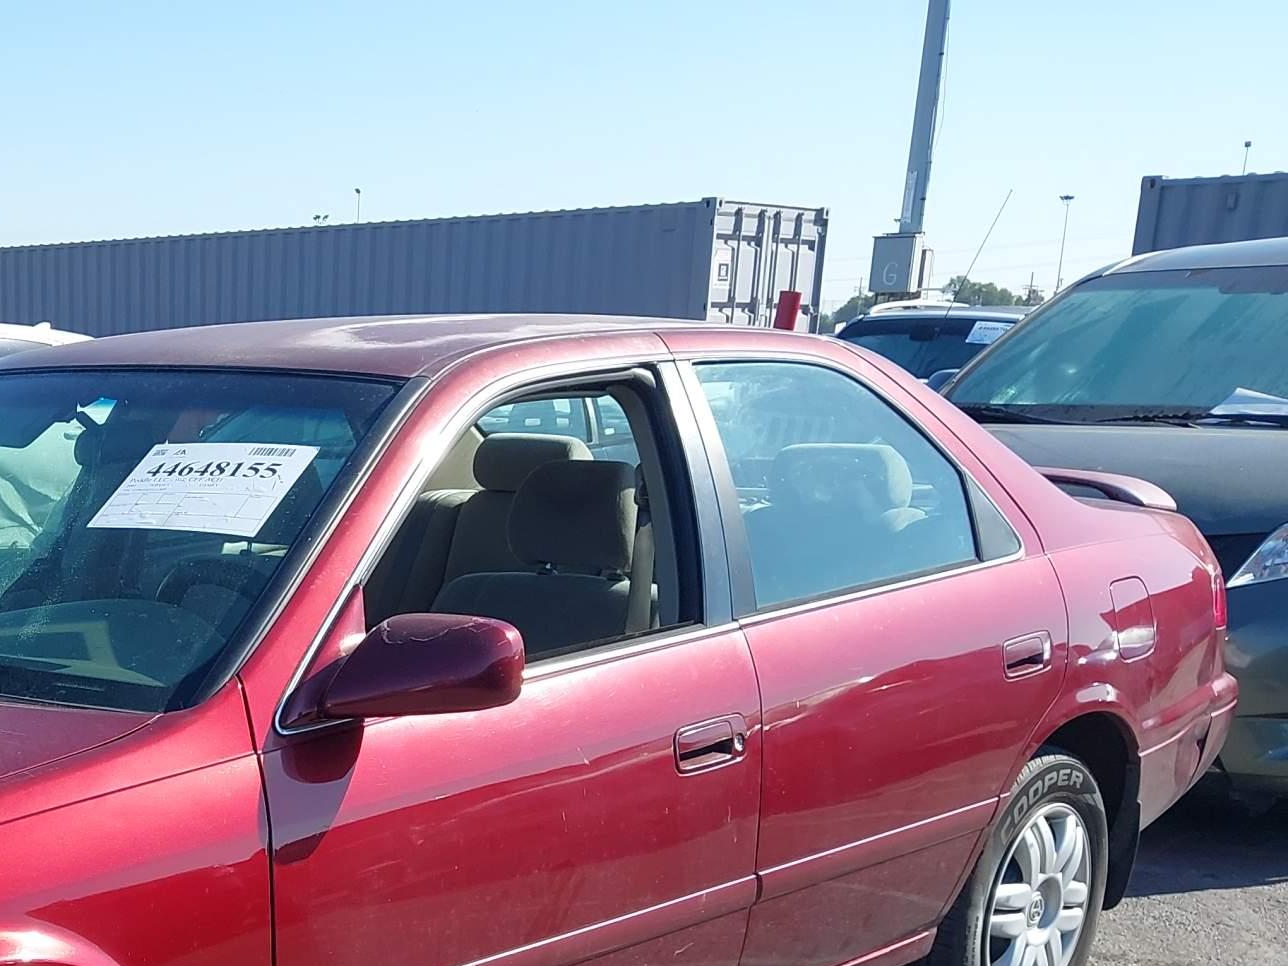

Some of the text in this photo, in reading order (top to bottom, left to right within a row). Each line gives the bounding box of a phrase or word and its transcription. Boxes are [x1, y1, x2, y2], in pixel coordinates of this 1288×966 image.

[882, 262, 898, 286] G
[146, 461, 284, 479] 44648155
[1000, 768, 1083, 846] COOPER
